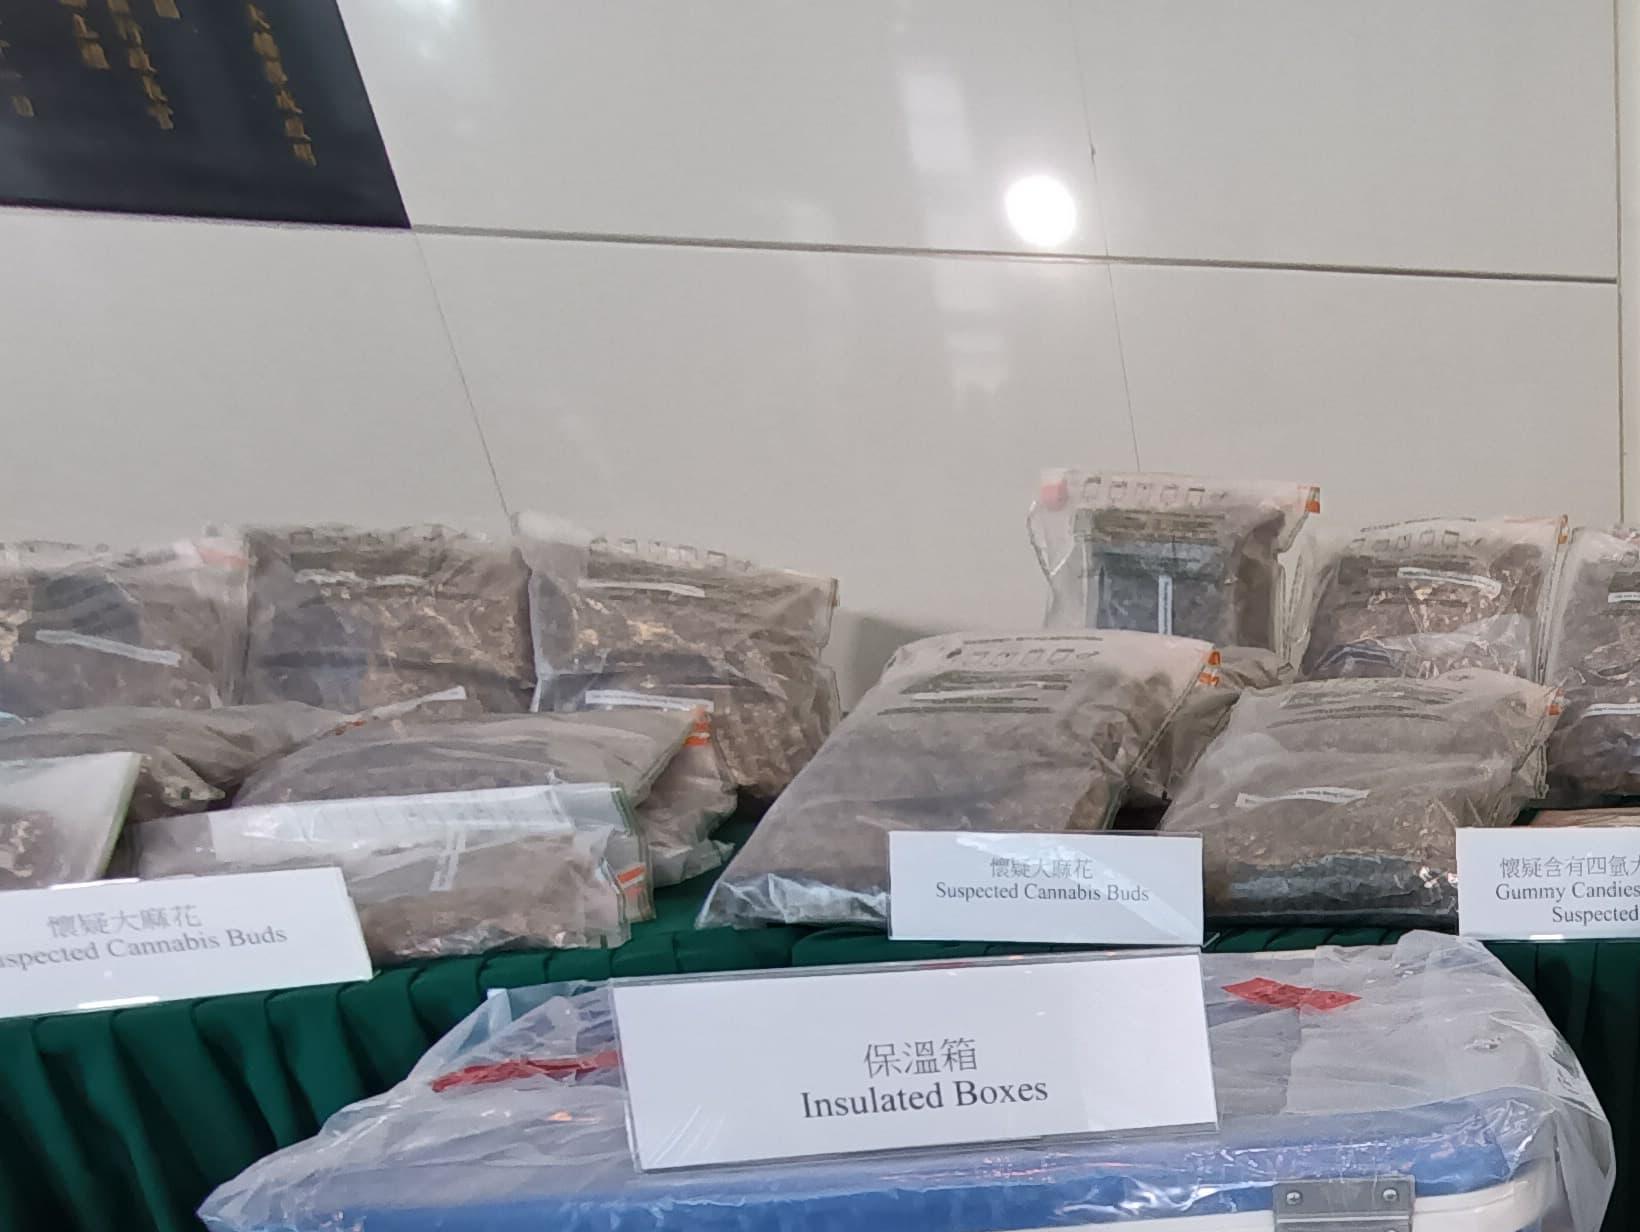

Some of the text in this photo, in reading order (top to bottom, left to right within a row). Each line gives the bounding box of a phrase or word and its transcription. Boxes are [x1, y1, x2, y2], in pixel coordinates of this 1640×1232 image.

[936, 881, 1150, 903] Suspected Cannabis Buds
[1495, 883, 1566, 903] Gummy
[1571, 881, 1640, 898] Candies
[47, 904, 202, 938] 懷疑大麻花
[1551, 904, 1639, 926] Suspected
[106, 931, 221, 958] Cannabis
[226, 925, 289, 947] Buds
[864, 1037, 978, 1078] 保溫箱
[801, 1079, 1048, 1118] Insulated Boxes
